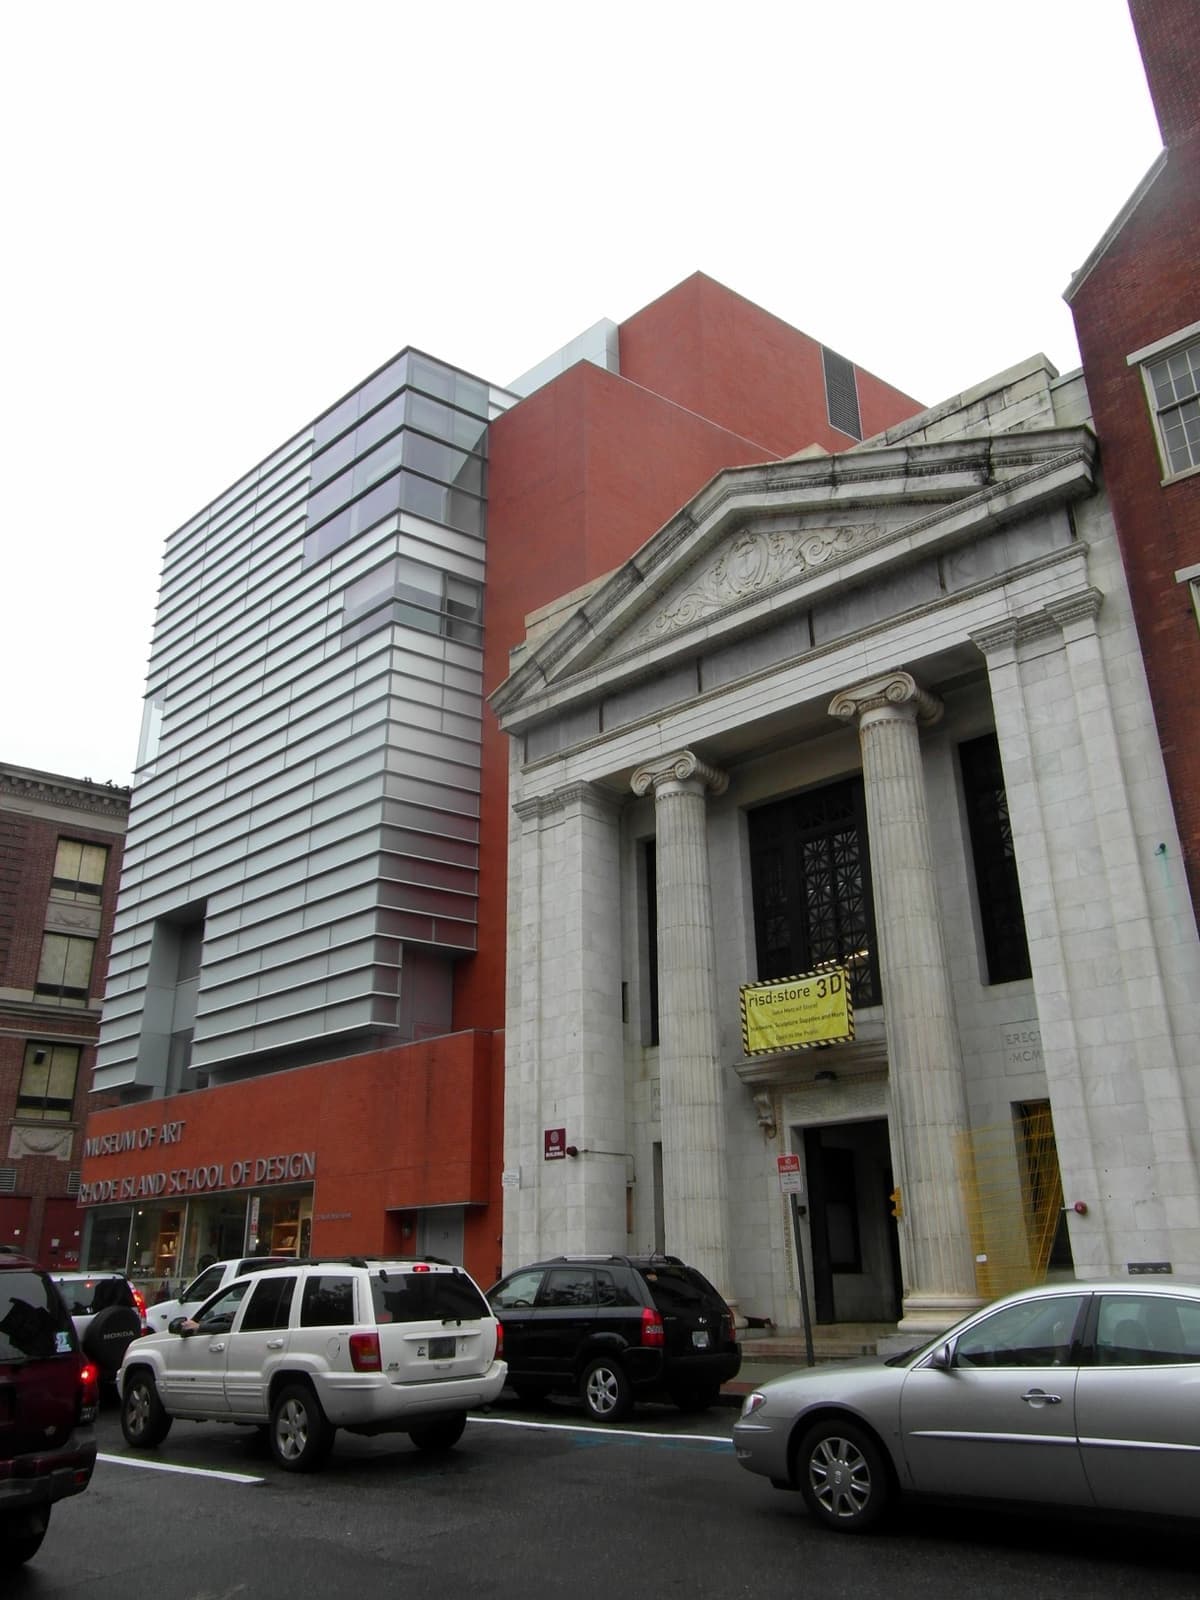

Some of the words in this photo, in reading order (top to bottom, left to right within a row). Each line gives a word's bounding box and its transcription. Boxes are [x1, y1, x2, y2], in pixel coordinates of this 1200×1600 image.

[748, 987, 810, 1008] risd:store
[816, 973, 842, 999] 3D
[83, 1130, 136, 1158] MUSEUM
[138, 1126, 158, 1150] OF
[159, 1120, 187, 1145] ART
[78, 1179, 118, 1203] RHODE
[120, 1172, 166, 1198] ISLAND
[168, 1164, 226, 1193] SCHOOL
[230, 1160, 253, 1185] OF
[255, 1151, 316, 1182] DESIGN
[103, 1330, 134, 1340] HONDA
